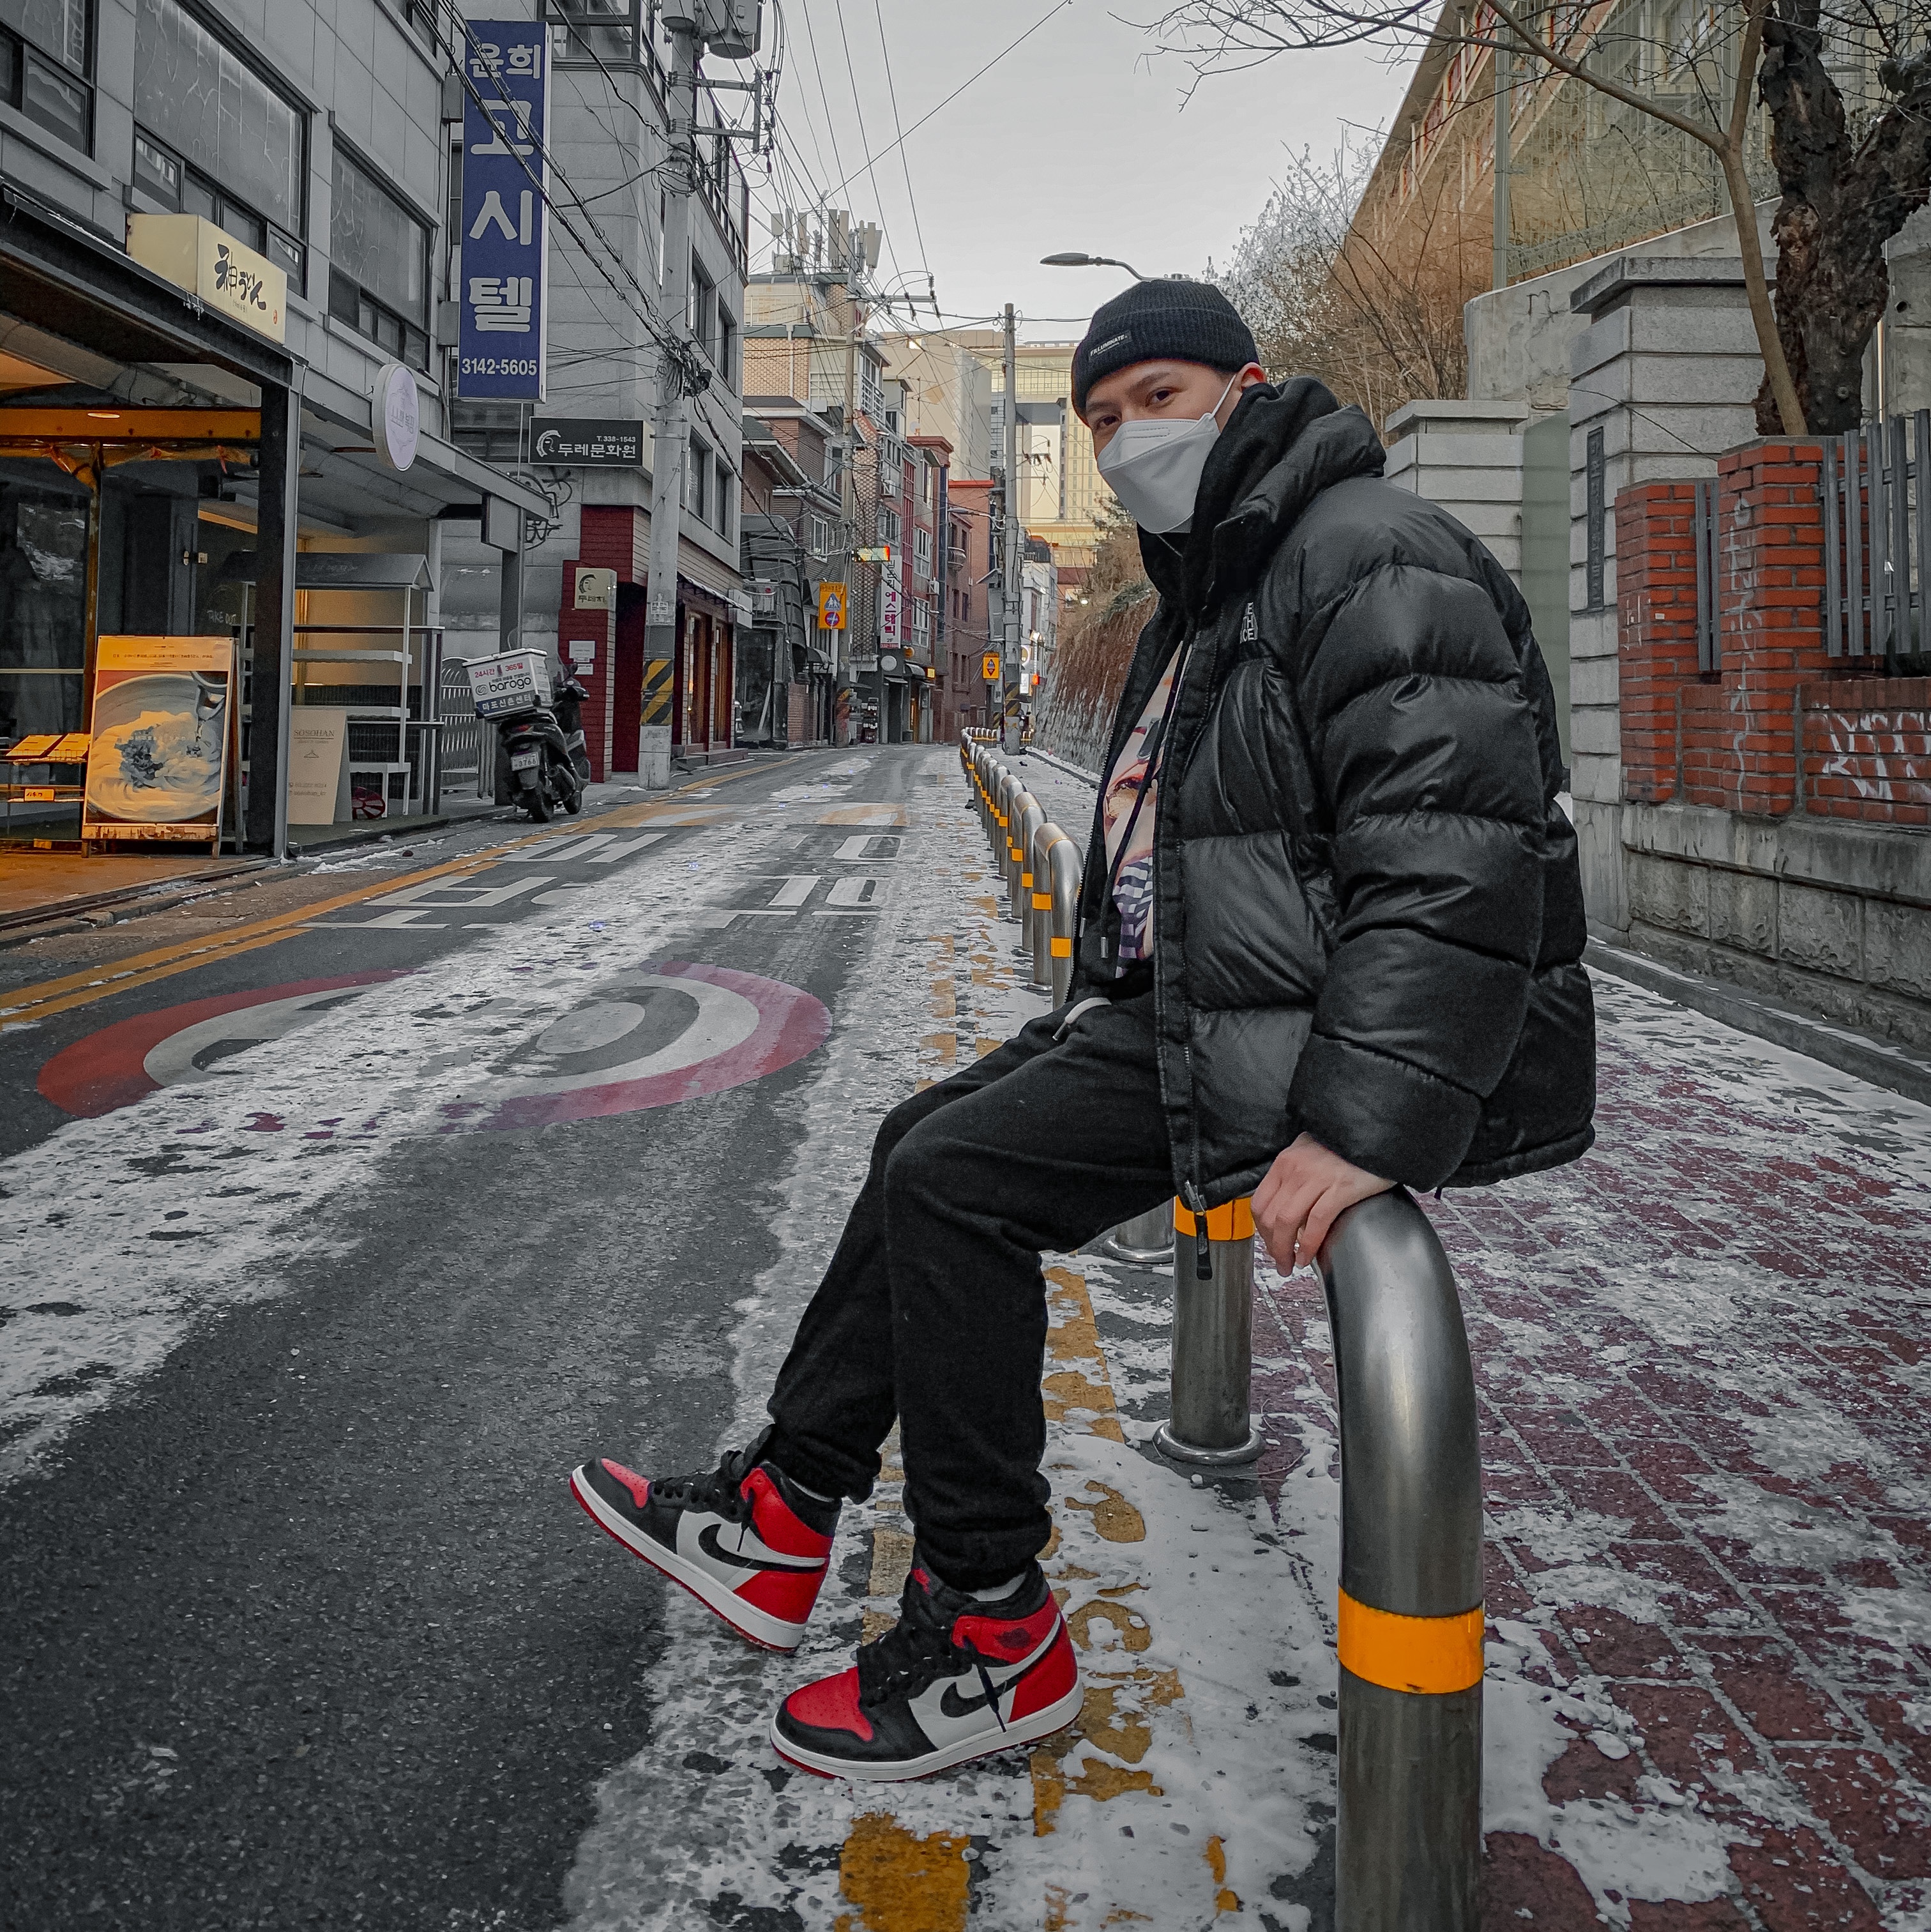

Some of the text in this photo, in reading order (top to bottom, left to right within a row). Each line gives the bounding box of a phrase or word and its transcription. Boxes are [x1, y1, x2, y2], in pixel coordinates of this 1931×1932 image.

[469, 43, 541, 79] 윤희
[469, 100, 534, 333] 고시텔
[462, 358, 538, 376] 3142-5605
[557, 443, 636, 459] 두레문화원
[474, 669, 495, 678] 24시간
[505, 662, 524, 672] 365일
[489, 677, 531, 692] barogo
